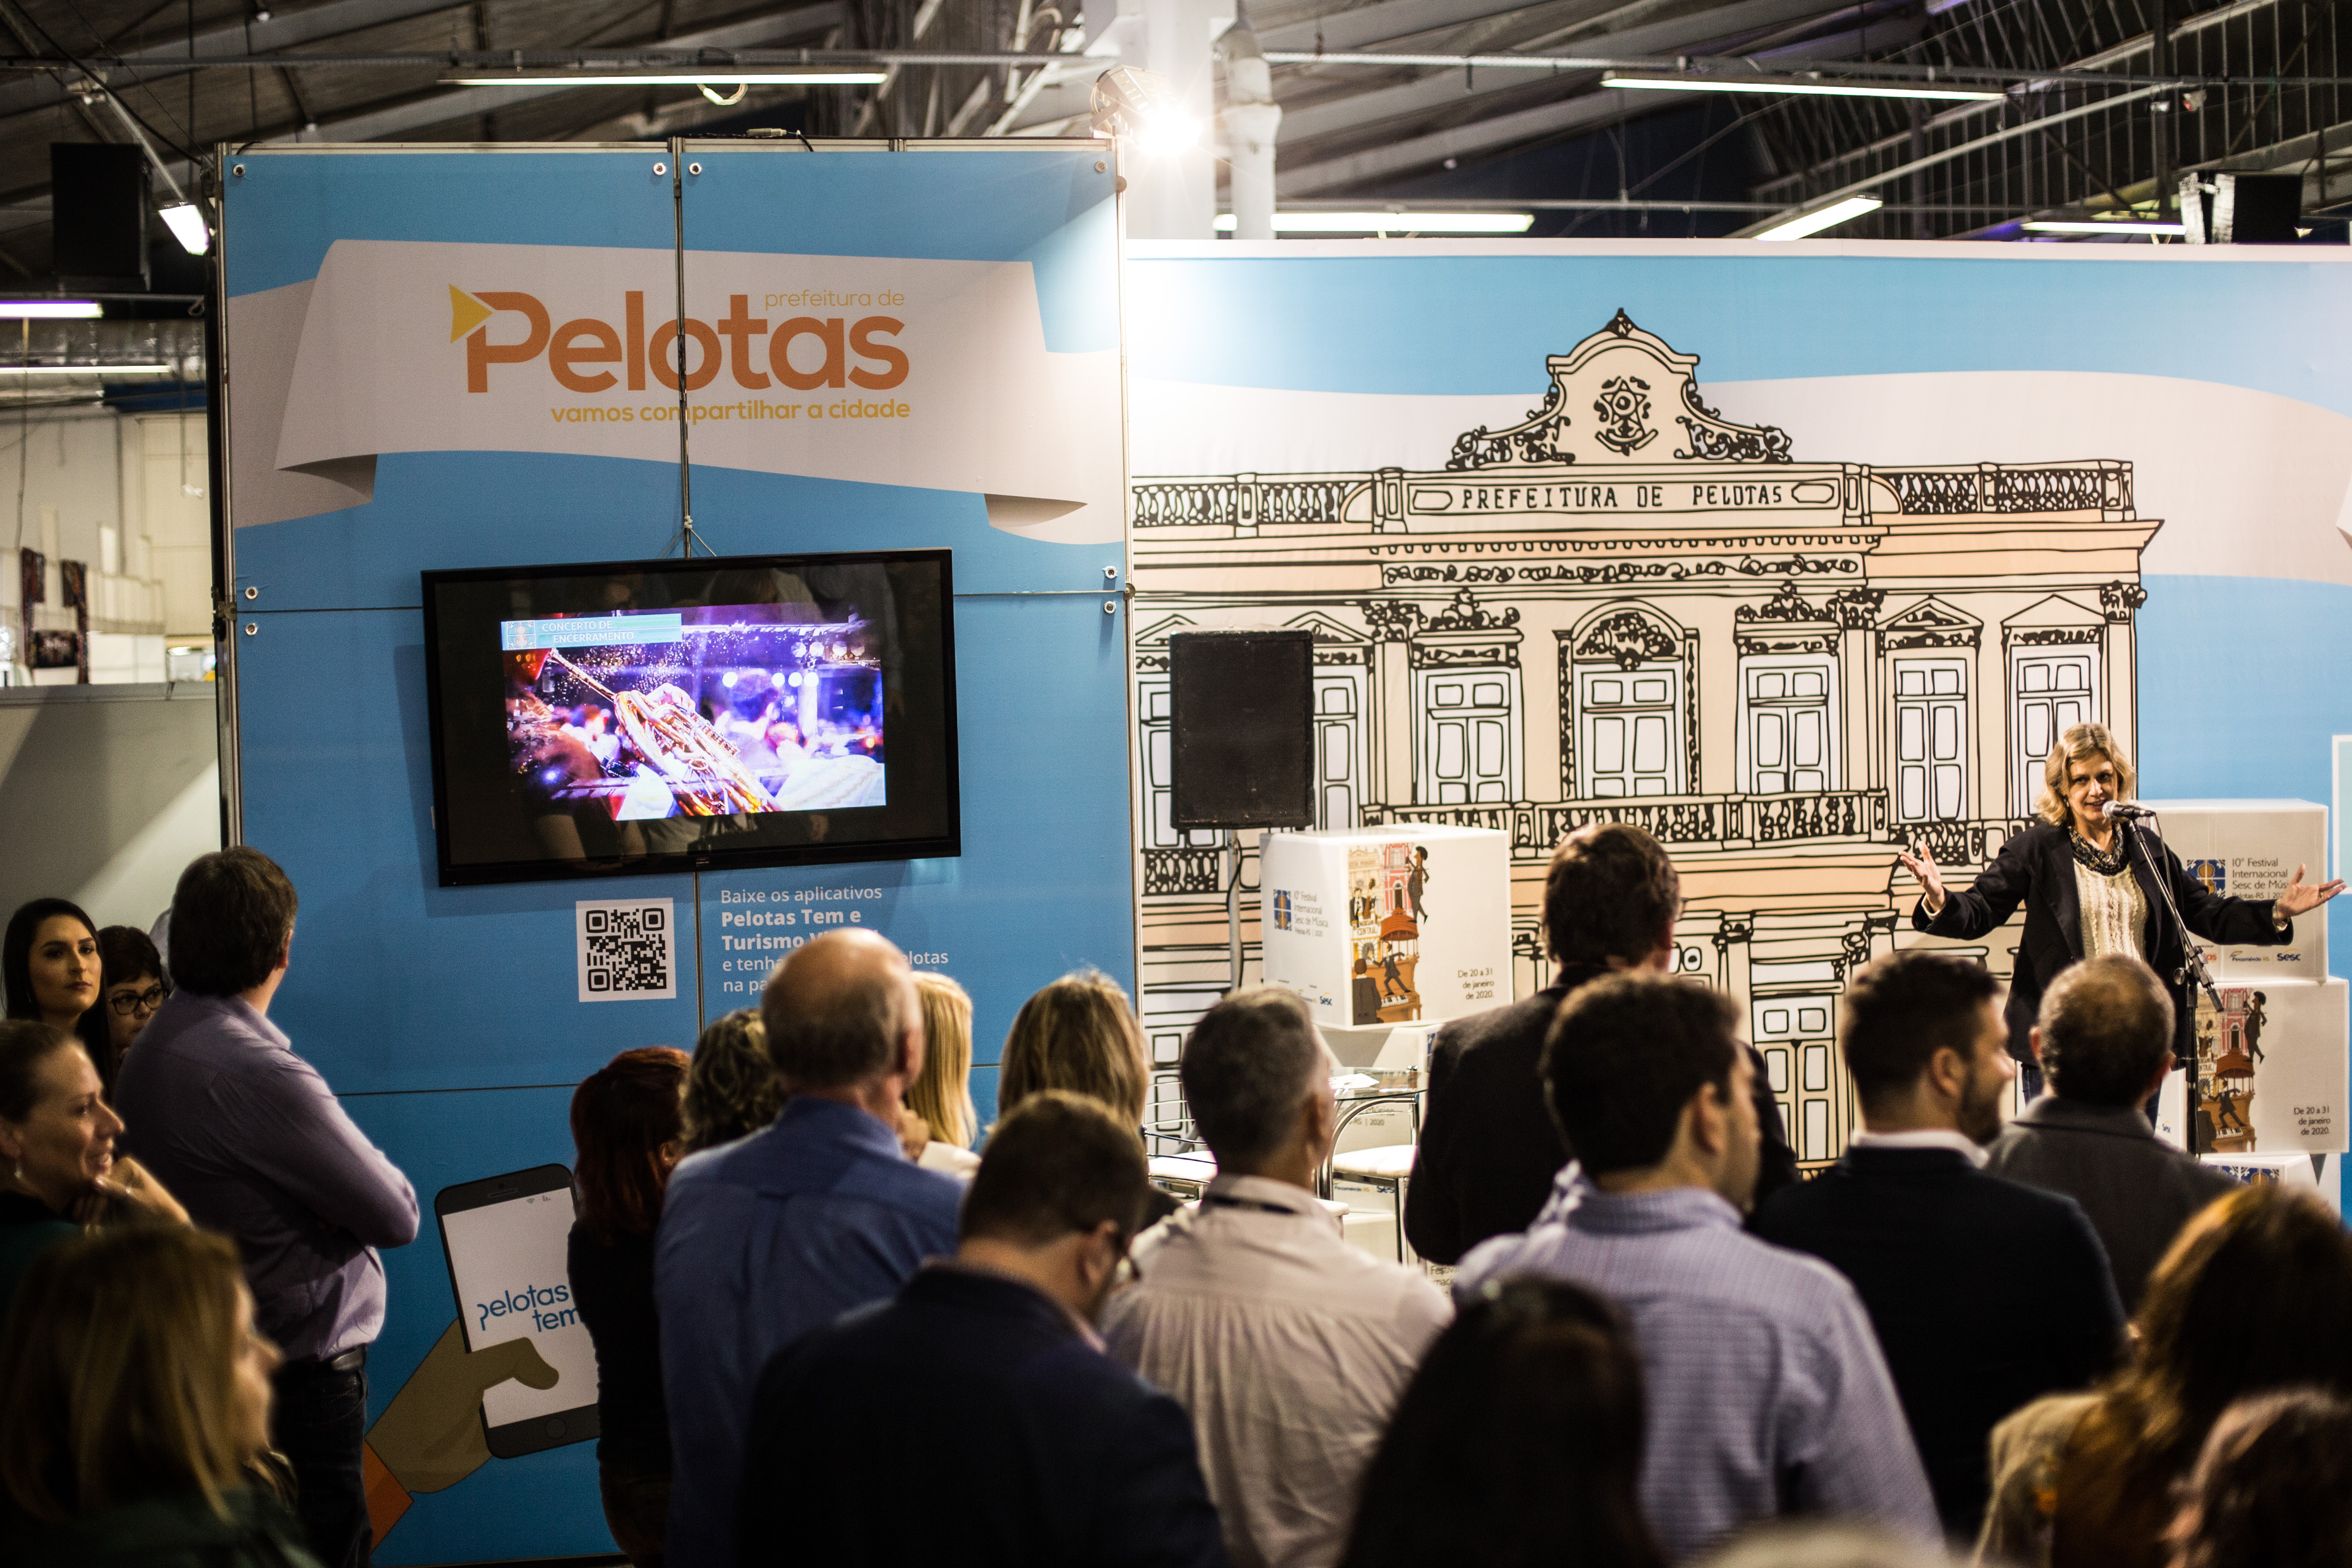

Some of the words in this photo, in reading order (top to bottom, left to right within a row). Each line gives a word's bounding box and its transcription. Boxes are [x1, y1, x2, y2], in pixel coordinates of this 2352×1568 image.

[765, 289, 871, 310] prefeitura
[878, 289, 905, 306] de
[467, 291, 910, 393] Pelotas
[551, 404, 634, 423] vamos
[640, 400, 802, 426] compartilhar
[807, 402, 823, 419] a
[828, 399, 910, 419] cidade
[1461, 487, 1618, 509] PREFEITURA
[1637, 486, 1663, 507] DE
[1693, 485, 1782, 505] PELOTAS
[542, 622, 597, 632] CONCERTO
[599, 620, 612, 629] DE
[553, 631, 634, 643] ENCERRAMENTO
[2248, 857, 2278, 867] Festival
[2233, 869, 2288, 878] Internacional
[2233, 880, 2252, 889] Sesc
[2254, 880, 2266, 889] de
[721, 889, 766, 904] Baixe
[771, 890, 789, 902] os
[794, 886, 882, 905] aplicativos
[721, 910, 796, 927] Pelotas
[801, 909, 844, 925] Tem
[850, 910, 861, 923] e
[721, 933, 804, 951] Turismo
[723, 960, 732, 971] e
[902, 950, 949, 965] elotas
[2277, 952, 2301, 961] Sesc
[1485, 967, 1492, 975] 31
[723, 981, 743, 992] na
[1472, 980, 1494, 990] janeiro
[1320, 995, 1332, 1005] Sesc
[1476, 990, 1494, 998] 2020.
[2308, 1117, 2331, 1126] janeiro
[477, 1285, 569, 1331] pelotas
[532, 1307, 583, 1332] tem
